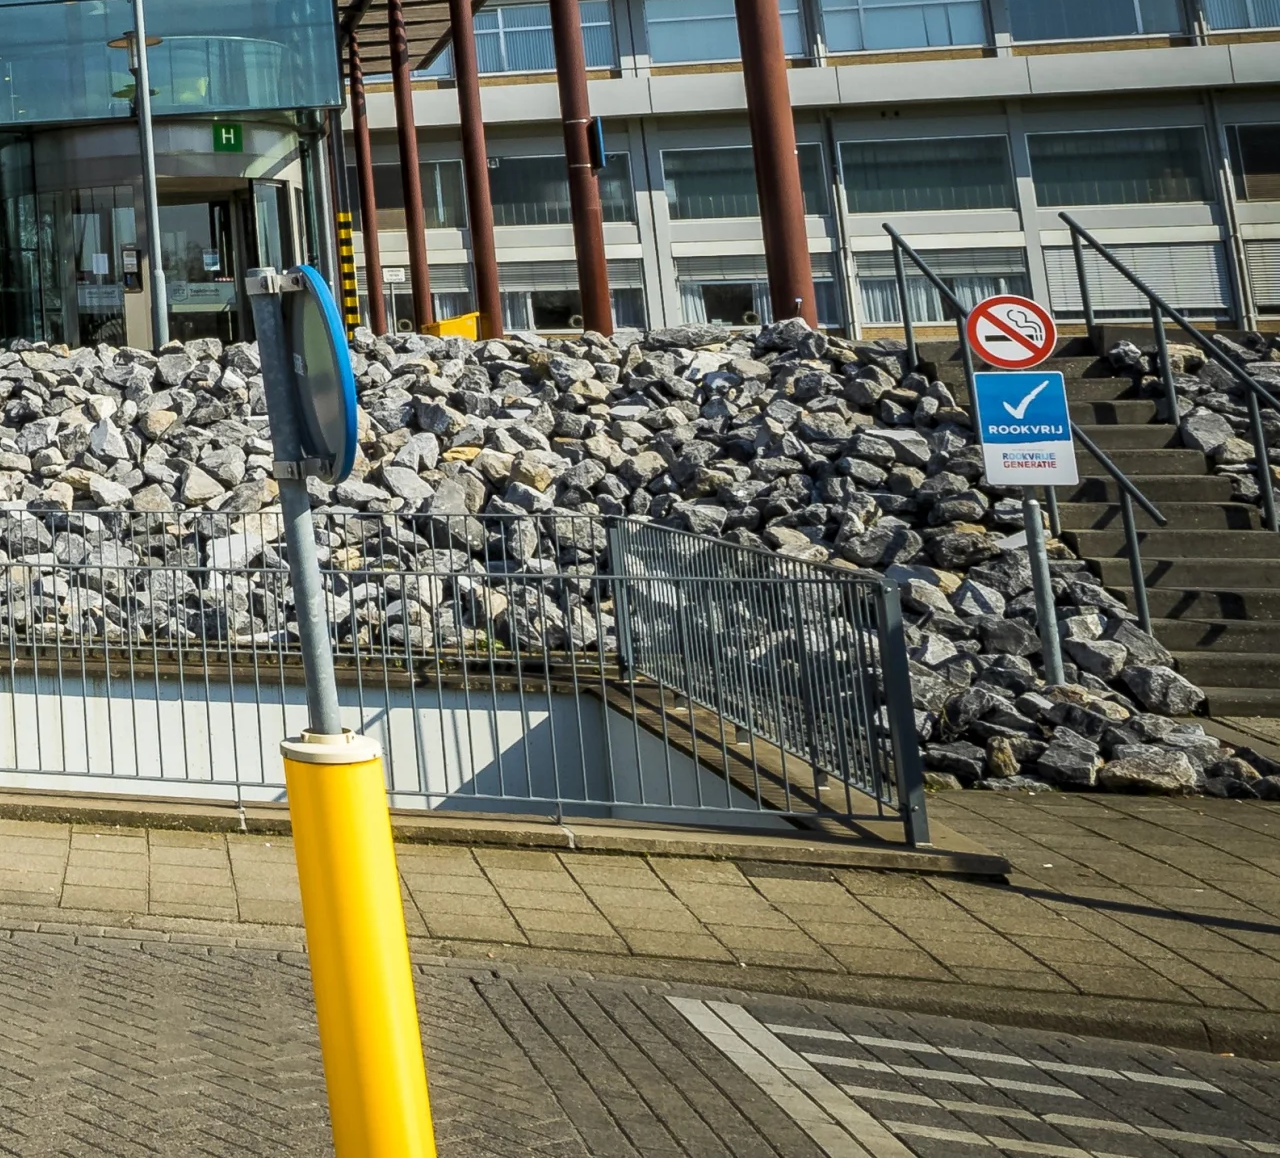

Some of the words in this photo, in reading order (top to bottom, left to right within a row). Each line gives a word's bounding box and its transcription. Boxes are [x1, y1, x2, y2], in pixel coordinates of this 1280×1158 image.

[222, 128, 234, 144] H
[988, 425, 1063, 434] ROOKVRIJ
[1002, 452, 1056, 461] ROOKVRIJE
[1003, 460, 1057, 469] GENERATIE
